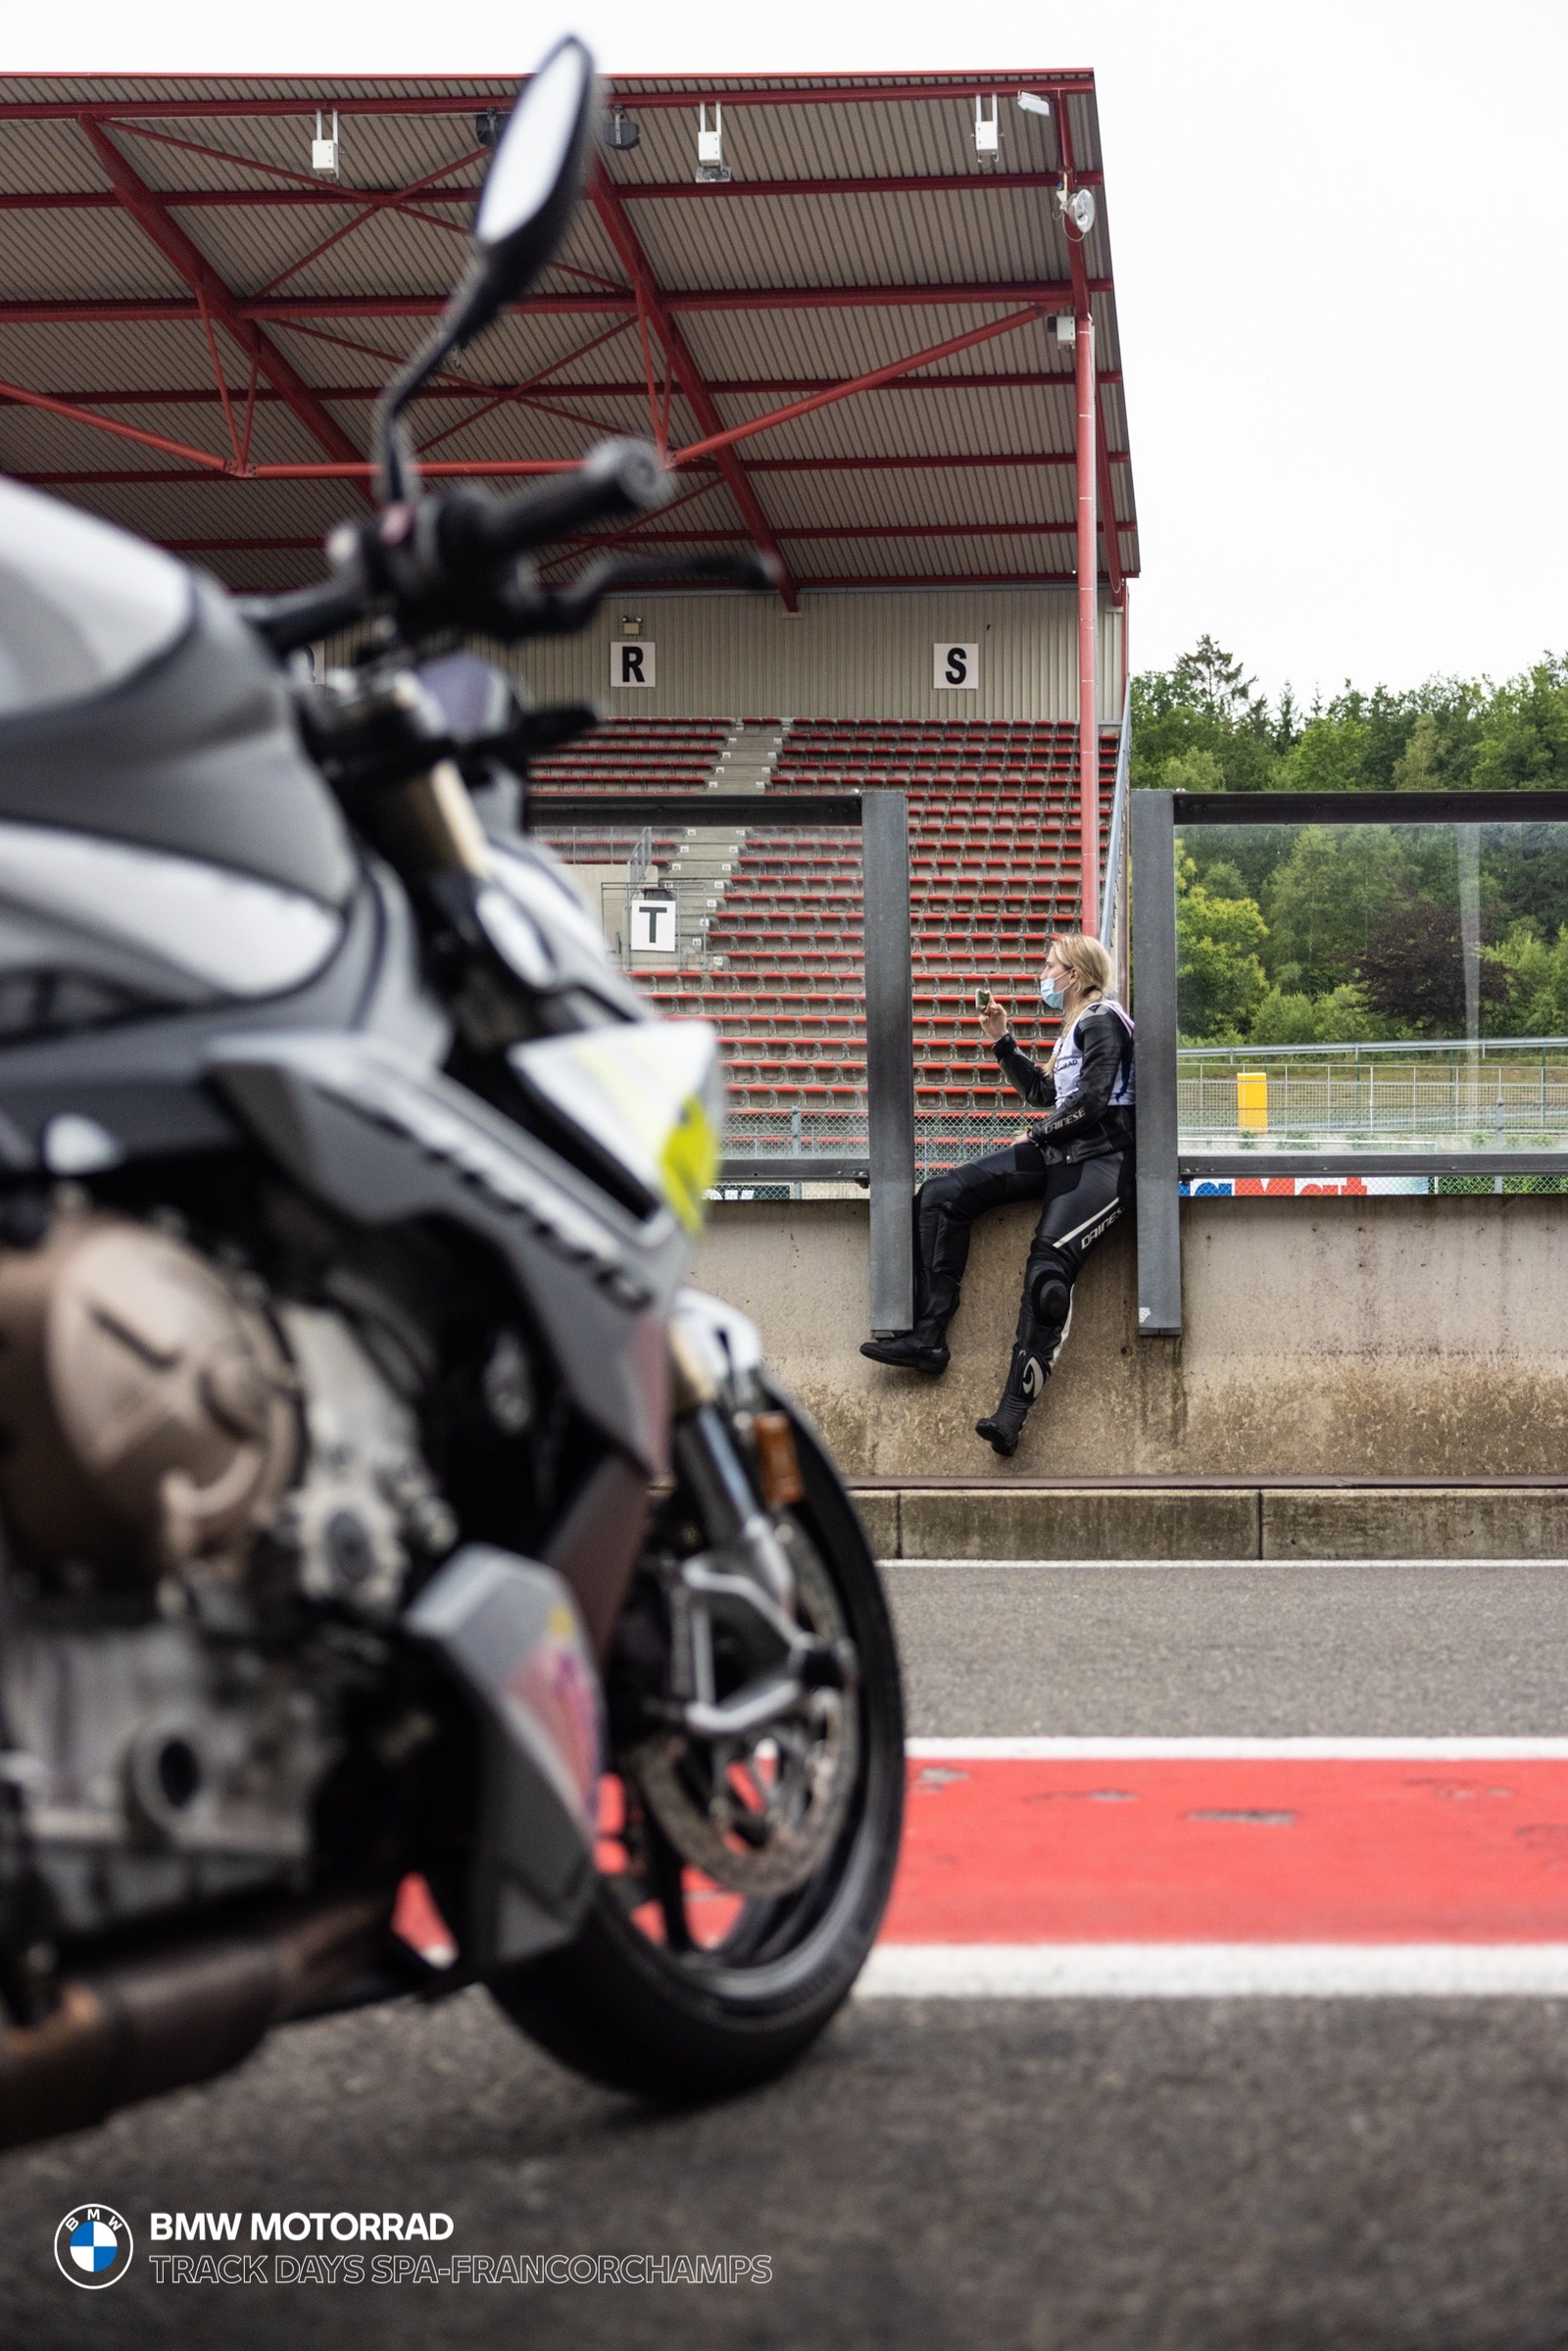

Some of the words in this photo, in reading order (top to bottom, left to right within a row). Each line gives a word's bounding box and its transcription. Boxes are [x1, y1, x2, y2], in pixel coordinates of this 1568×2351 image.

[621, 646, 646, 683] R
[945, 647, 967, 685] S
[639, 906, 667, 943] T
[1045, 1106, 1086, 1135] DAINESE
[1081, 1206, 1126, 1249] DAINES
